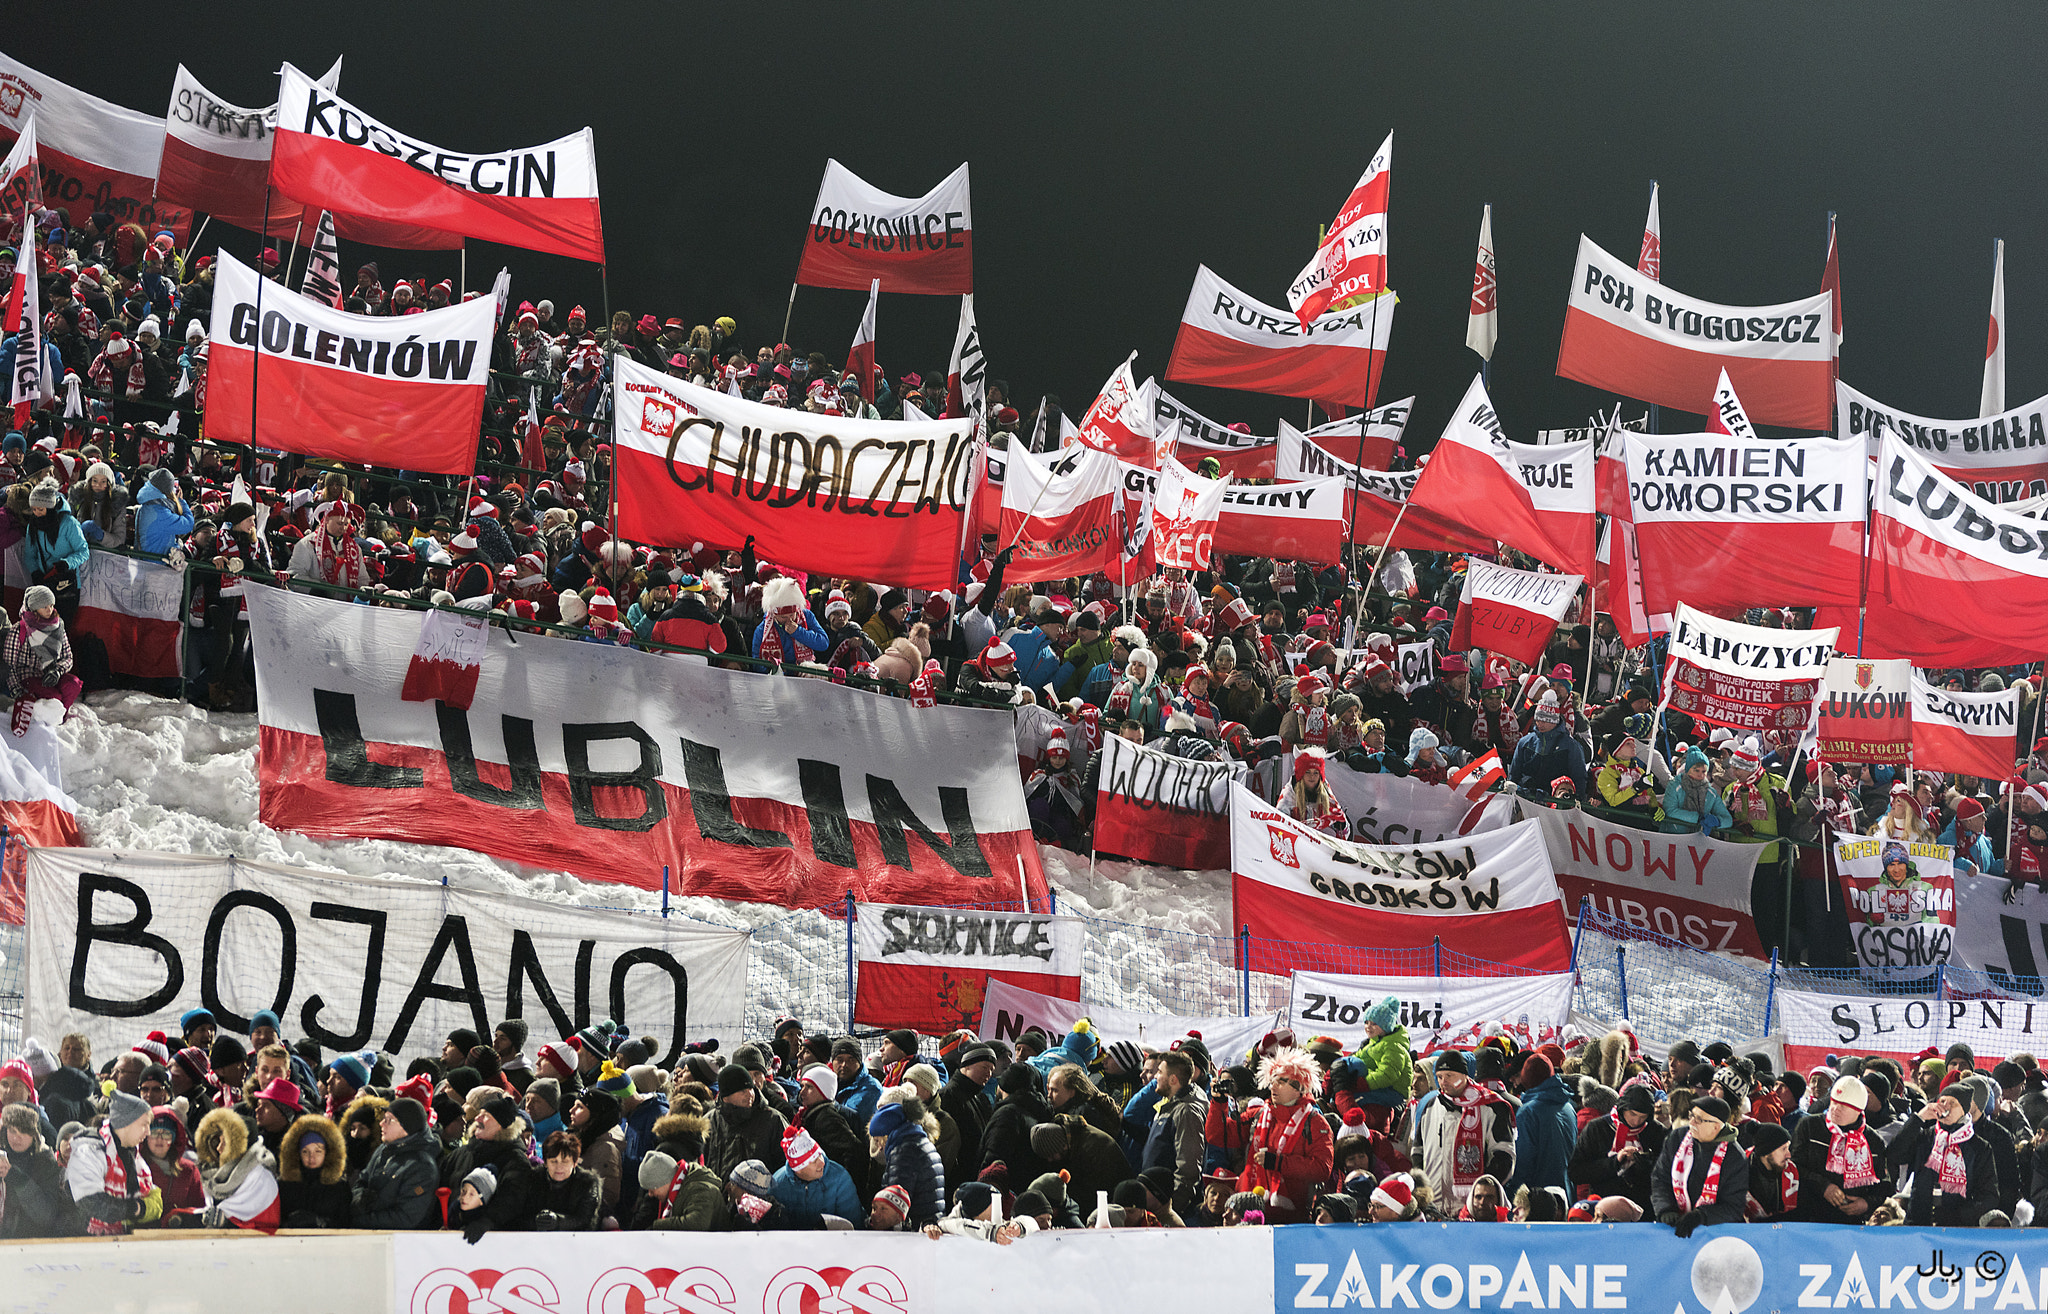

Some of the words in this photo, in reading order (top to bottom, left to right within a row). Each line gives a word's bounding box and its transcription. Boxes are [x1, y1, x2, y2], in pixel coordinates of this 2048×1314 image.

[814, 206, 964, 252] GOŁKOWICE
[1212, 291, 1365, 337] RURZYCA
[1584, 264, 1635, 312] PSH
[1645, 293, 1821, 344] BYDGOSZCZ
[229, 302, 477, 381] GOLENIÓW
[625, 382, 662, 398] KOCHAMY
[1645, 443, 1805, 478] KAMIEŃ
[1631, 482, 1843, 513] POMORSKI
[1676, 621, 1833, 669] ŁAPCZYCE
[1709, 671, 1749, 688] KIBICUJEMY
[1715, 683, 1773, 703] WOJTEK
[1701, 694, 1744, 713] KIBICUJEMY
[1705, 704, 1765, 727] BARTEK
[1925, 692, 2014, 726] SAWIN
[1820, 740, 1858, 753] KAMIL
[1860, 742, 1906, 755] STOCH
[313, 688, 992, 878] LUBLIN
[1567, 822, 1715, 886] NOWY
[1310, 871, 1499, 911] GRODKÓW
[1558, 886, 1744, 953] LUBOSZ
[69, 872, 688, 1070] BOJANO
[1294, 1248, 1627, 1310] ZAKOPANE
